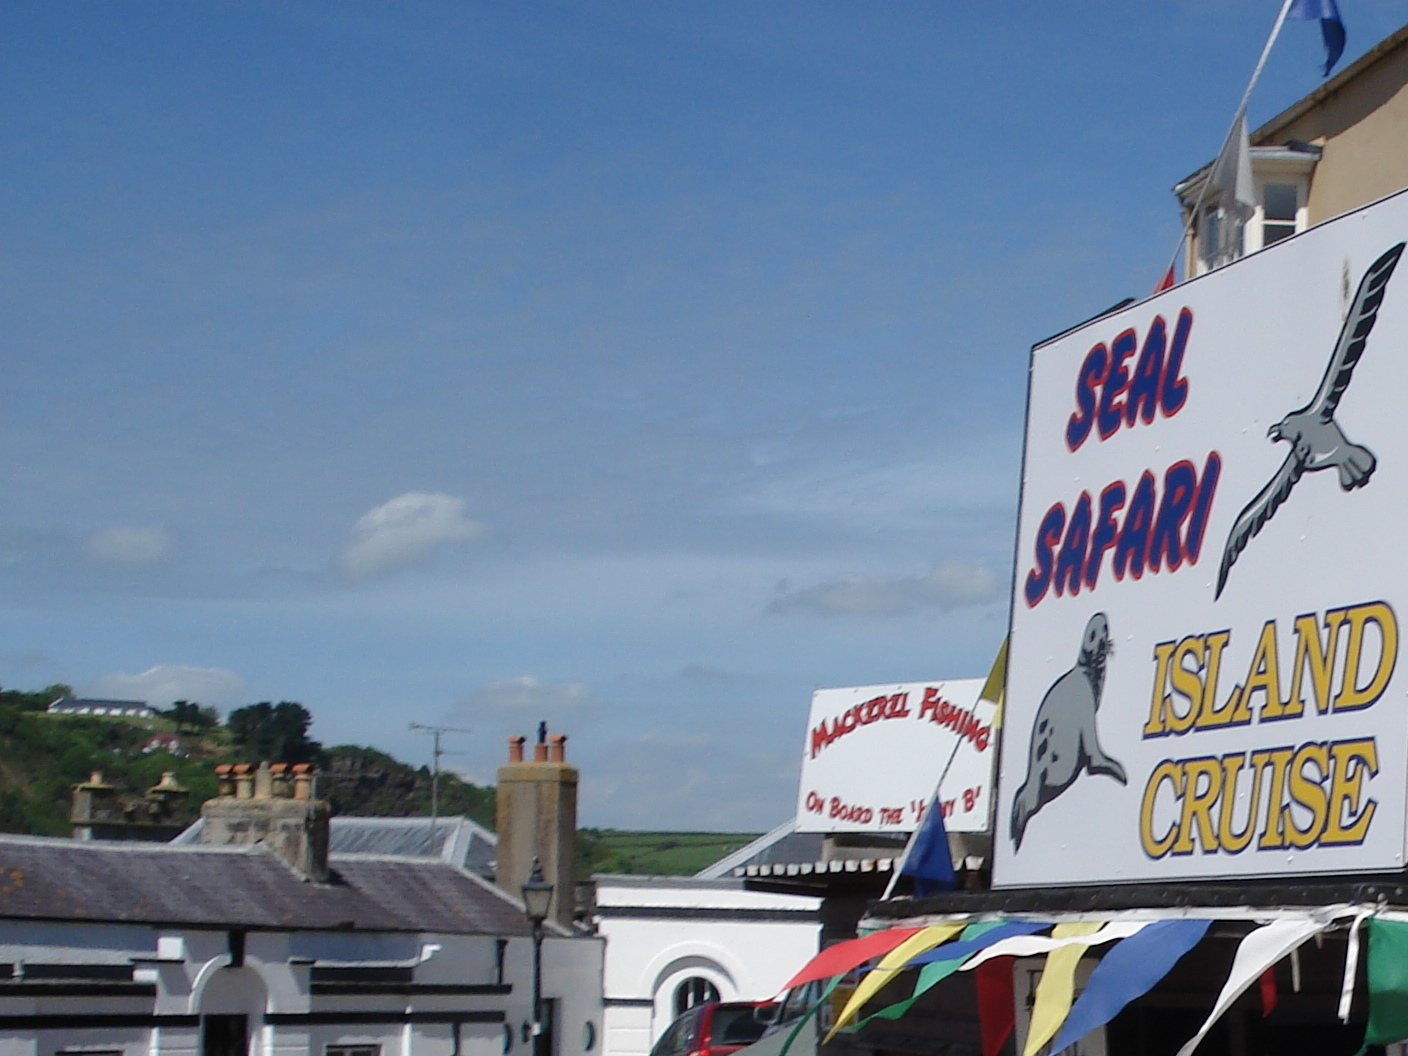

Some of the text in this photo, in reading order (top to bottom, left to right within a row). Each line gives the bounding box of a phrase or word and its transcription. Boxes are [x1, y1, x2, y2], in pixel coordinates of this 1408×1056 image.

[1065, 306, 1193, 453] SEAL
[1023, 450, 1223, 609] SAFARI
[811, 687, 990, 760] MACKEREL FISHING
[1141, 600, 1399, 740] ISLAND
[806, 791, 825, 814] ON
[829, 797, 872, 824] BOARD
[879, 807, 905, 825] THE
[1139, 736, 1379, 860] CRUISE
